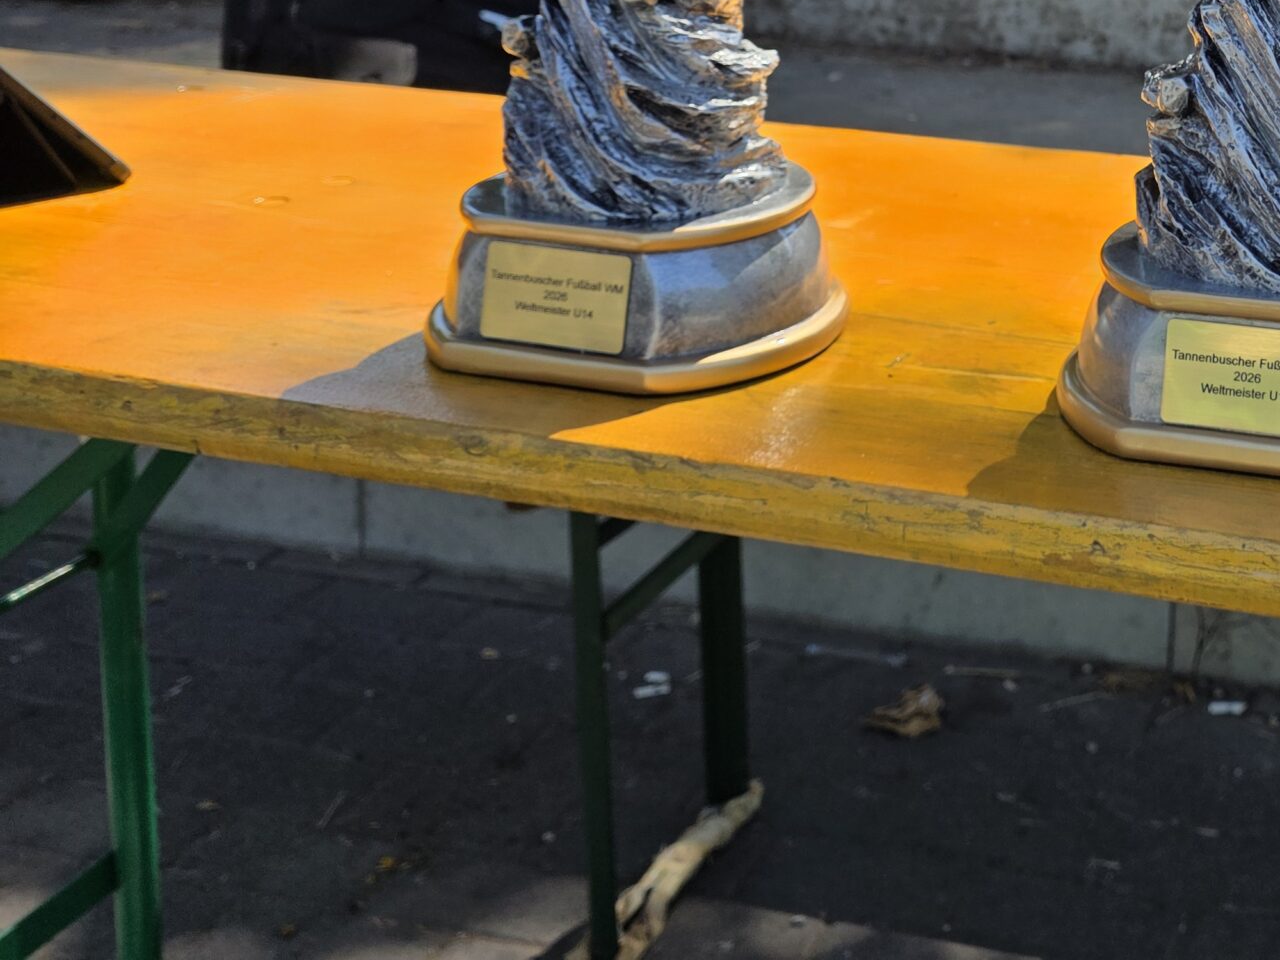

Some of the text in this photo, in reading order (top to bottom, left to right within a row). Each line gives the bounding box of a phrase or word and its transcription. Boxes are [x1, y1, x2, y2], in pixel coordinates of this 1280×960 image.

[491, 269, 623, 294] Tannenbuscher Fußball WM
[543, 290, 568, 302] 2026
[515, 300, 571, 316] Weltmeister
[1172, 349, 1255, 368] Tannenbuscher
[1233, 371, 1261, 384] 2026
[1201, 382, 1266, 400] Weltmeister
